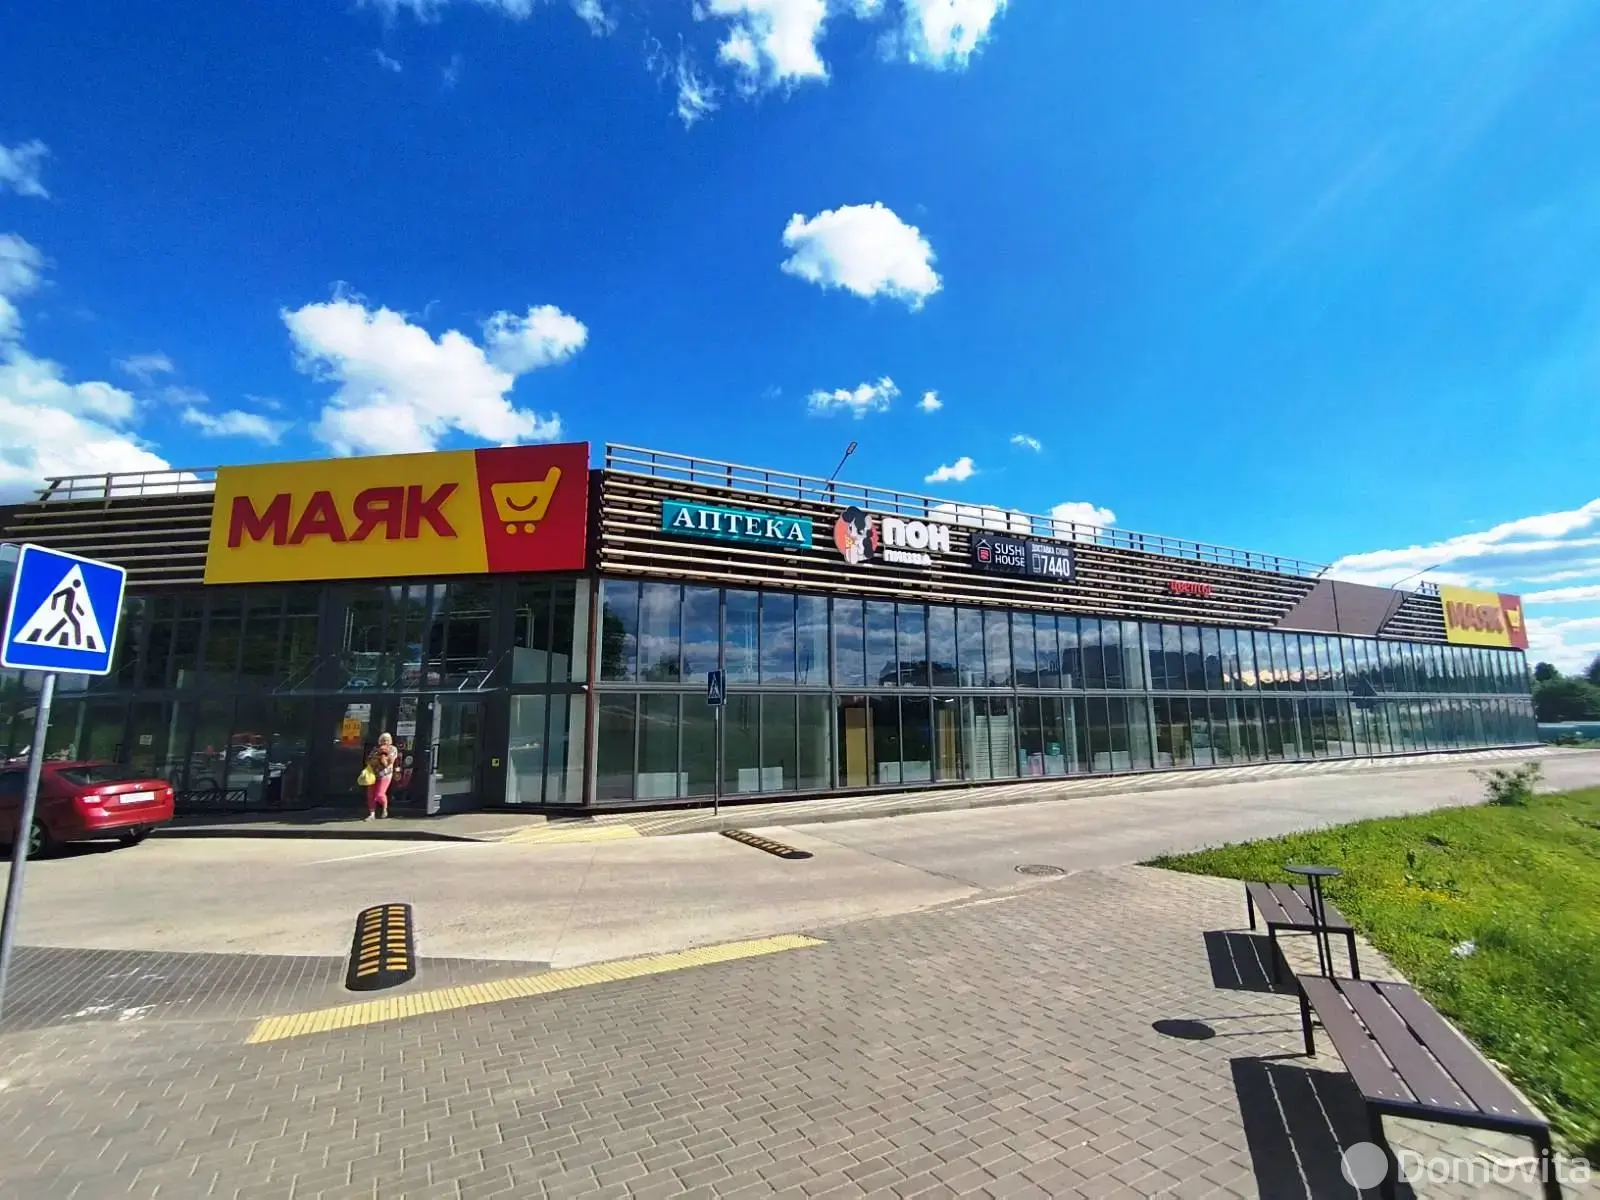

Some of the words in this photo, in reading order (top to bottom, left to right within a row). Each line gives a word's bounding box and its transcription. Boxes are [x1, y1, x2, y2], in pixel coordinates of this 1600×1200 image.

[227, 482, 460, 549] МАЯК
[673, 507, 805, 541] АПТЕКА
[882, 517, 950, 552] ПОН
[994, 543, 1025, 557] SUSHI
[995, 555, 1026, 567] HOUSE
[1041, 556, 1070, 577] 7440
[1446, 600, 1504, 634] МАЯК
